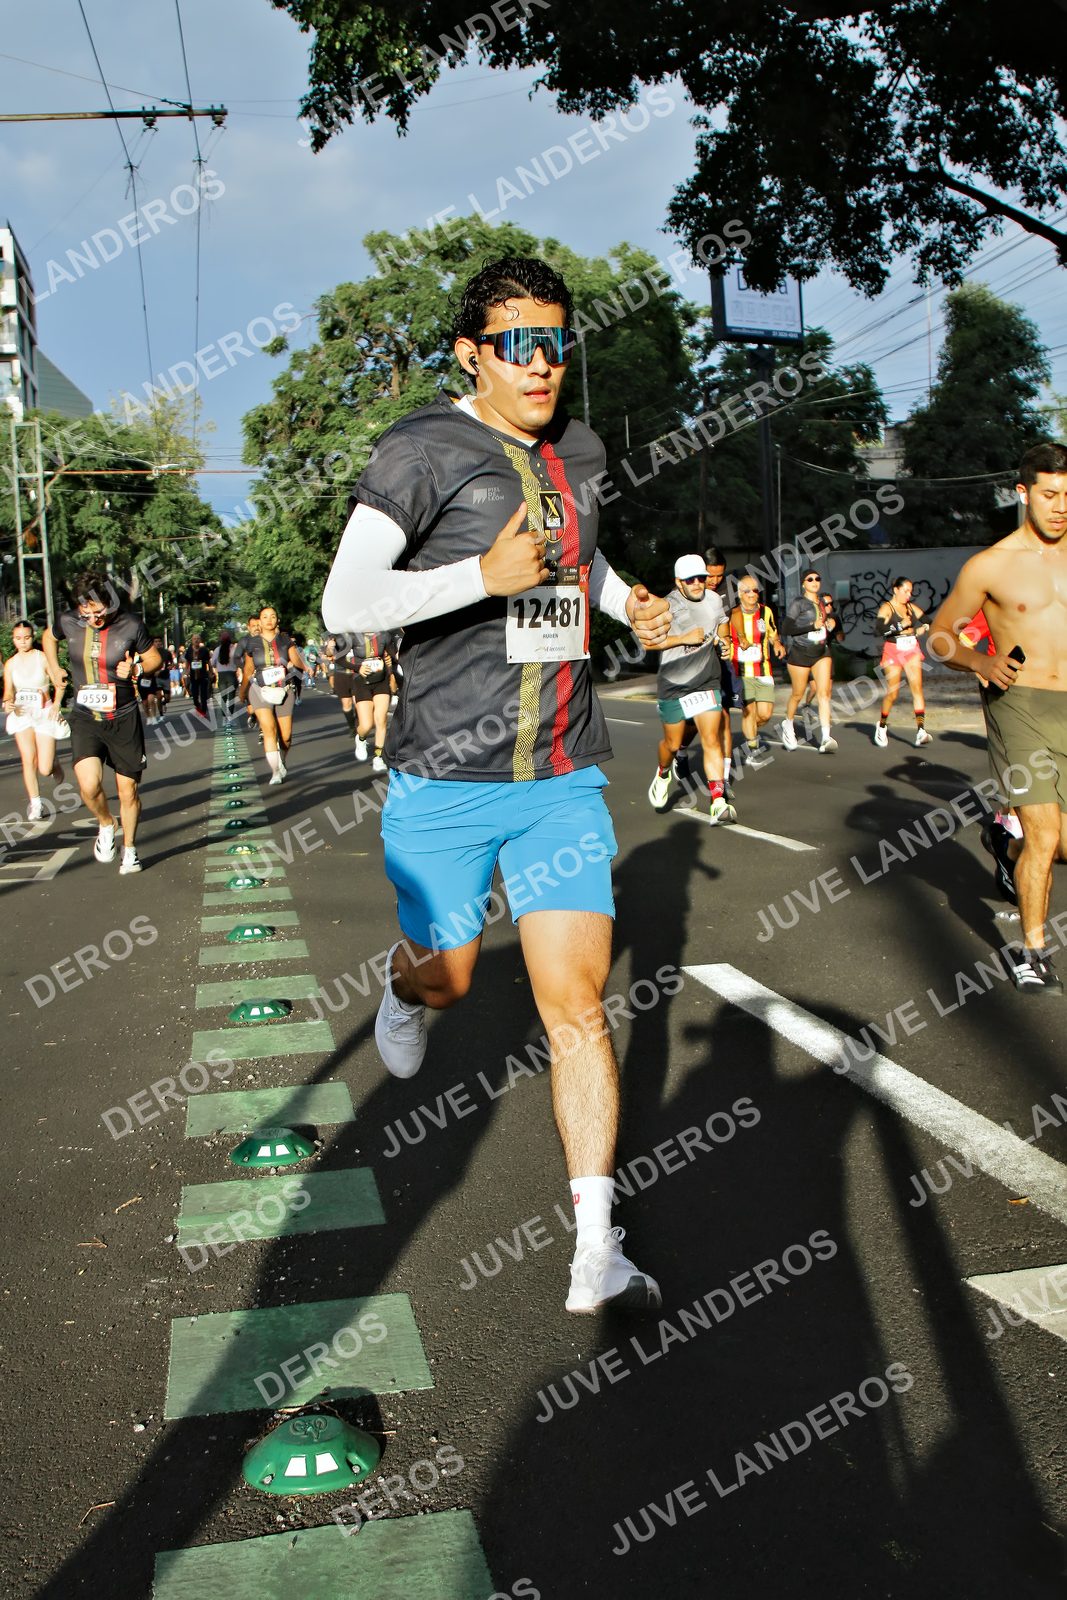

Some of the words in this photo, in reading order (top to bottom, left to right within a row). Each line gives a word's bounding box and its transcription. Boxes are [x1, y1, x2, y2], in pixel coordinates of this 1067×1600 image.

[850, 568, 892, 583] TOY
[513, 597, 580, 629] 12481
[82, 693, 109, 704] 9559
